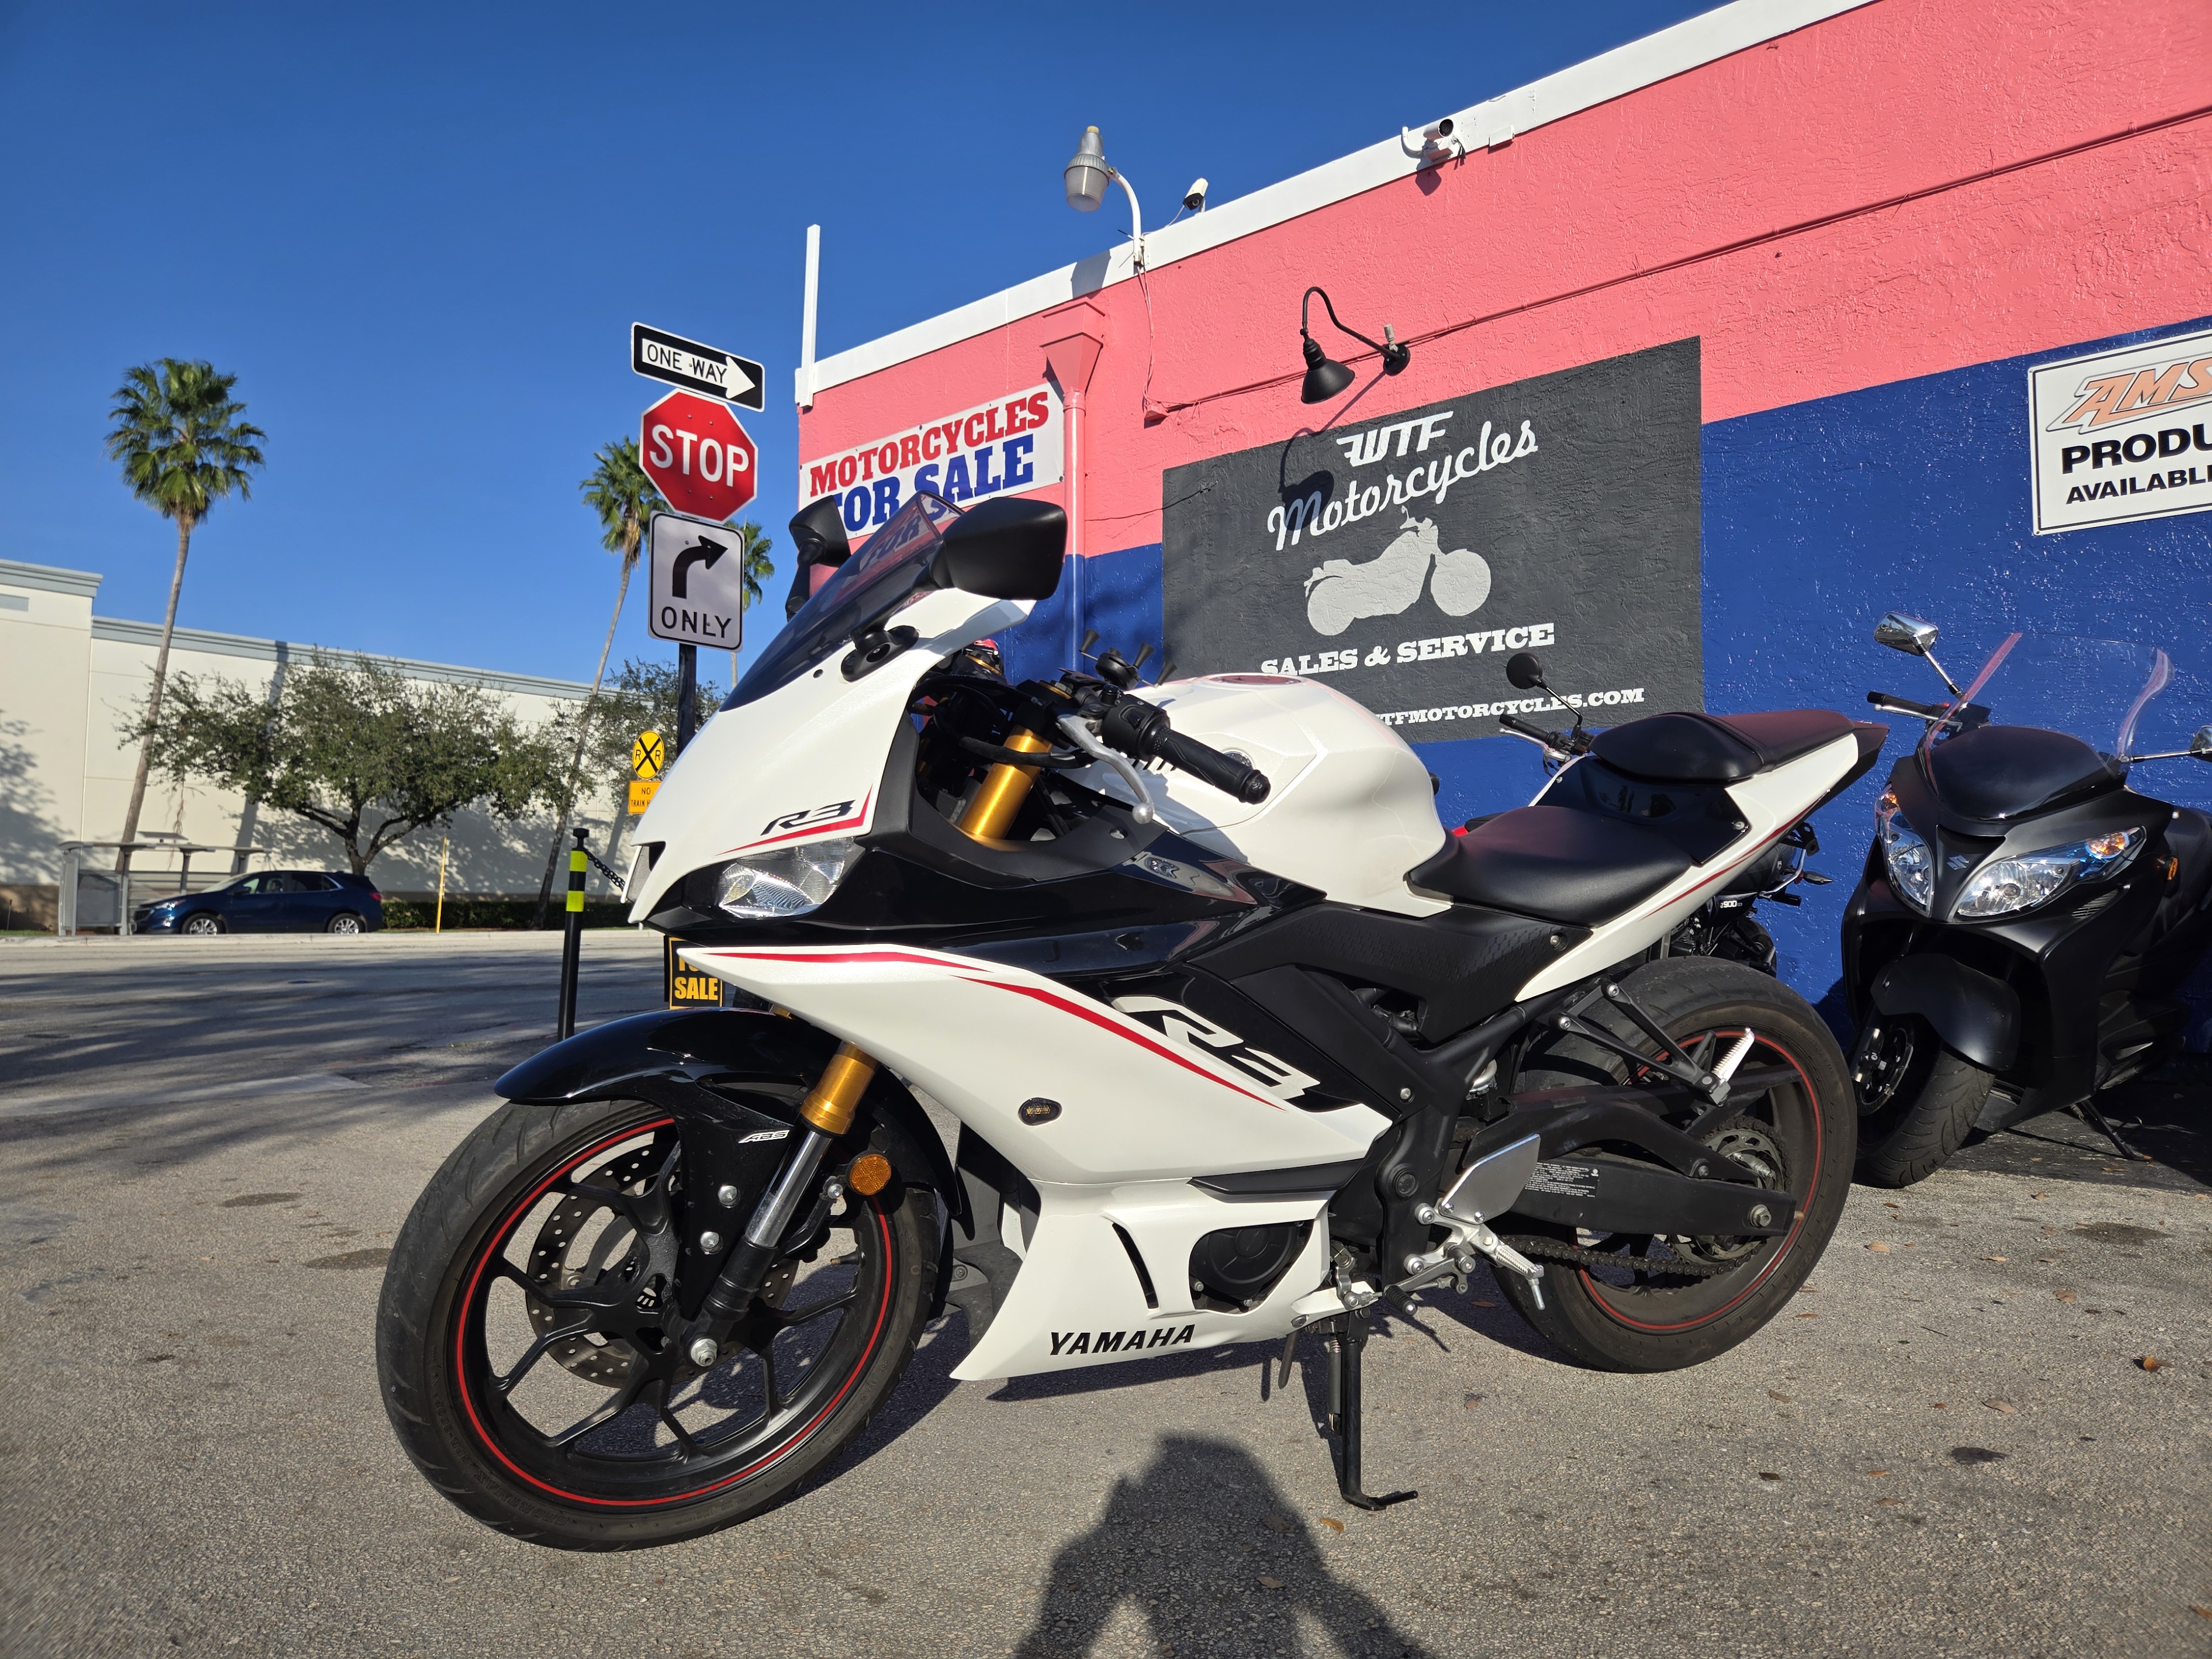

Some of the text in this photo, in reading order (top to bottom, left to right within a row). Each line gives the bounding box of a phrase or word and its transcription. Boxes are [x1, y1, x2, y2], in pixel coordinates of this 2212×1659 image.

[647, 344, 727, 384] ONE WAY
[650, 424, 749, 487] STOP
[810, 392, 1049, 497] MOTORCYCLES
[1337, 411, 1453, 467] WTF
[2062, 423, 2212, 474] PRODU
[833, 434, 1034, 532] OR SALE
[1267, 420, 1538, 551] Motorcycles
[661, 607, 732, 639] ONLY
[1261, 623, 1554, 675] SALES & SERVICE
[1374, 688, 1645, 726] TFMOTORCYCLES.COM
[635, 749, 661, 761] R R
[641, 787, 651, 795] NO
[760, 800, 855, 836] R3
[675, 977, 718, 1000] SALE
[740, 1130, 789, 1143] ABS
[1050, 1324, 1196, 1355] YAMAHA
[473, 1469, 570, 1526] SPORTMAX
